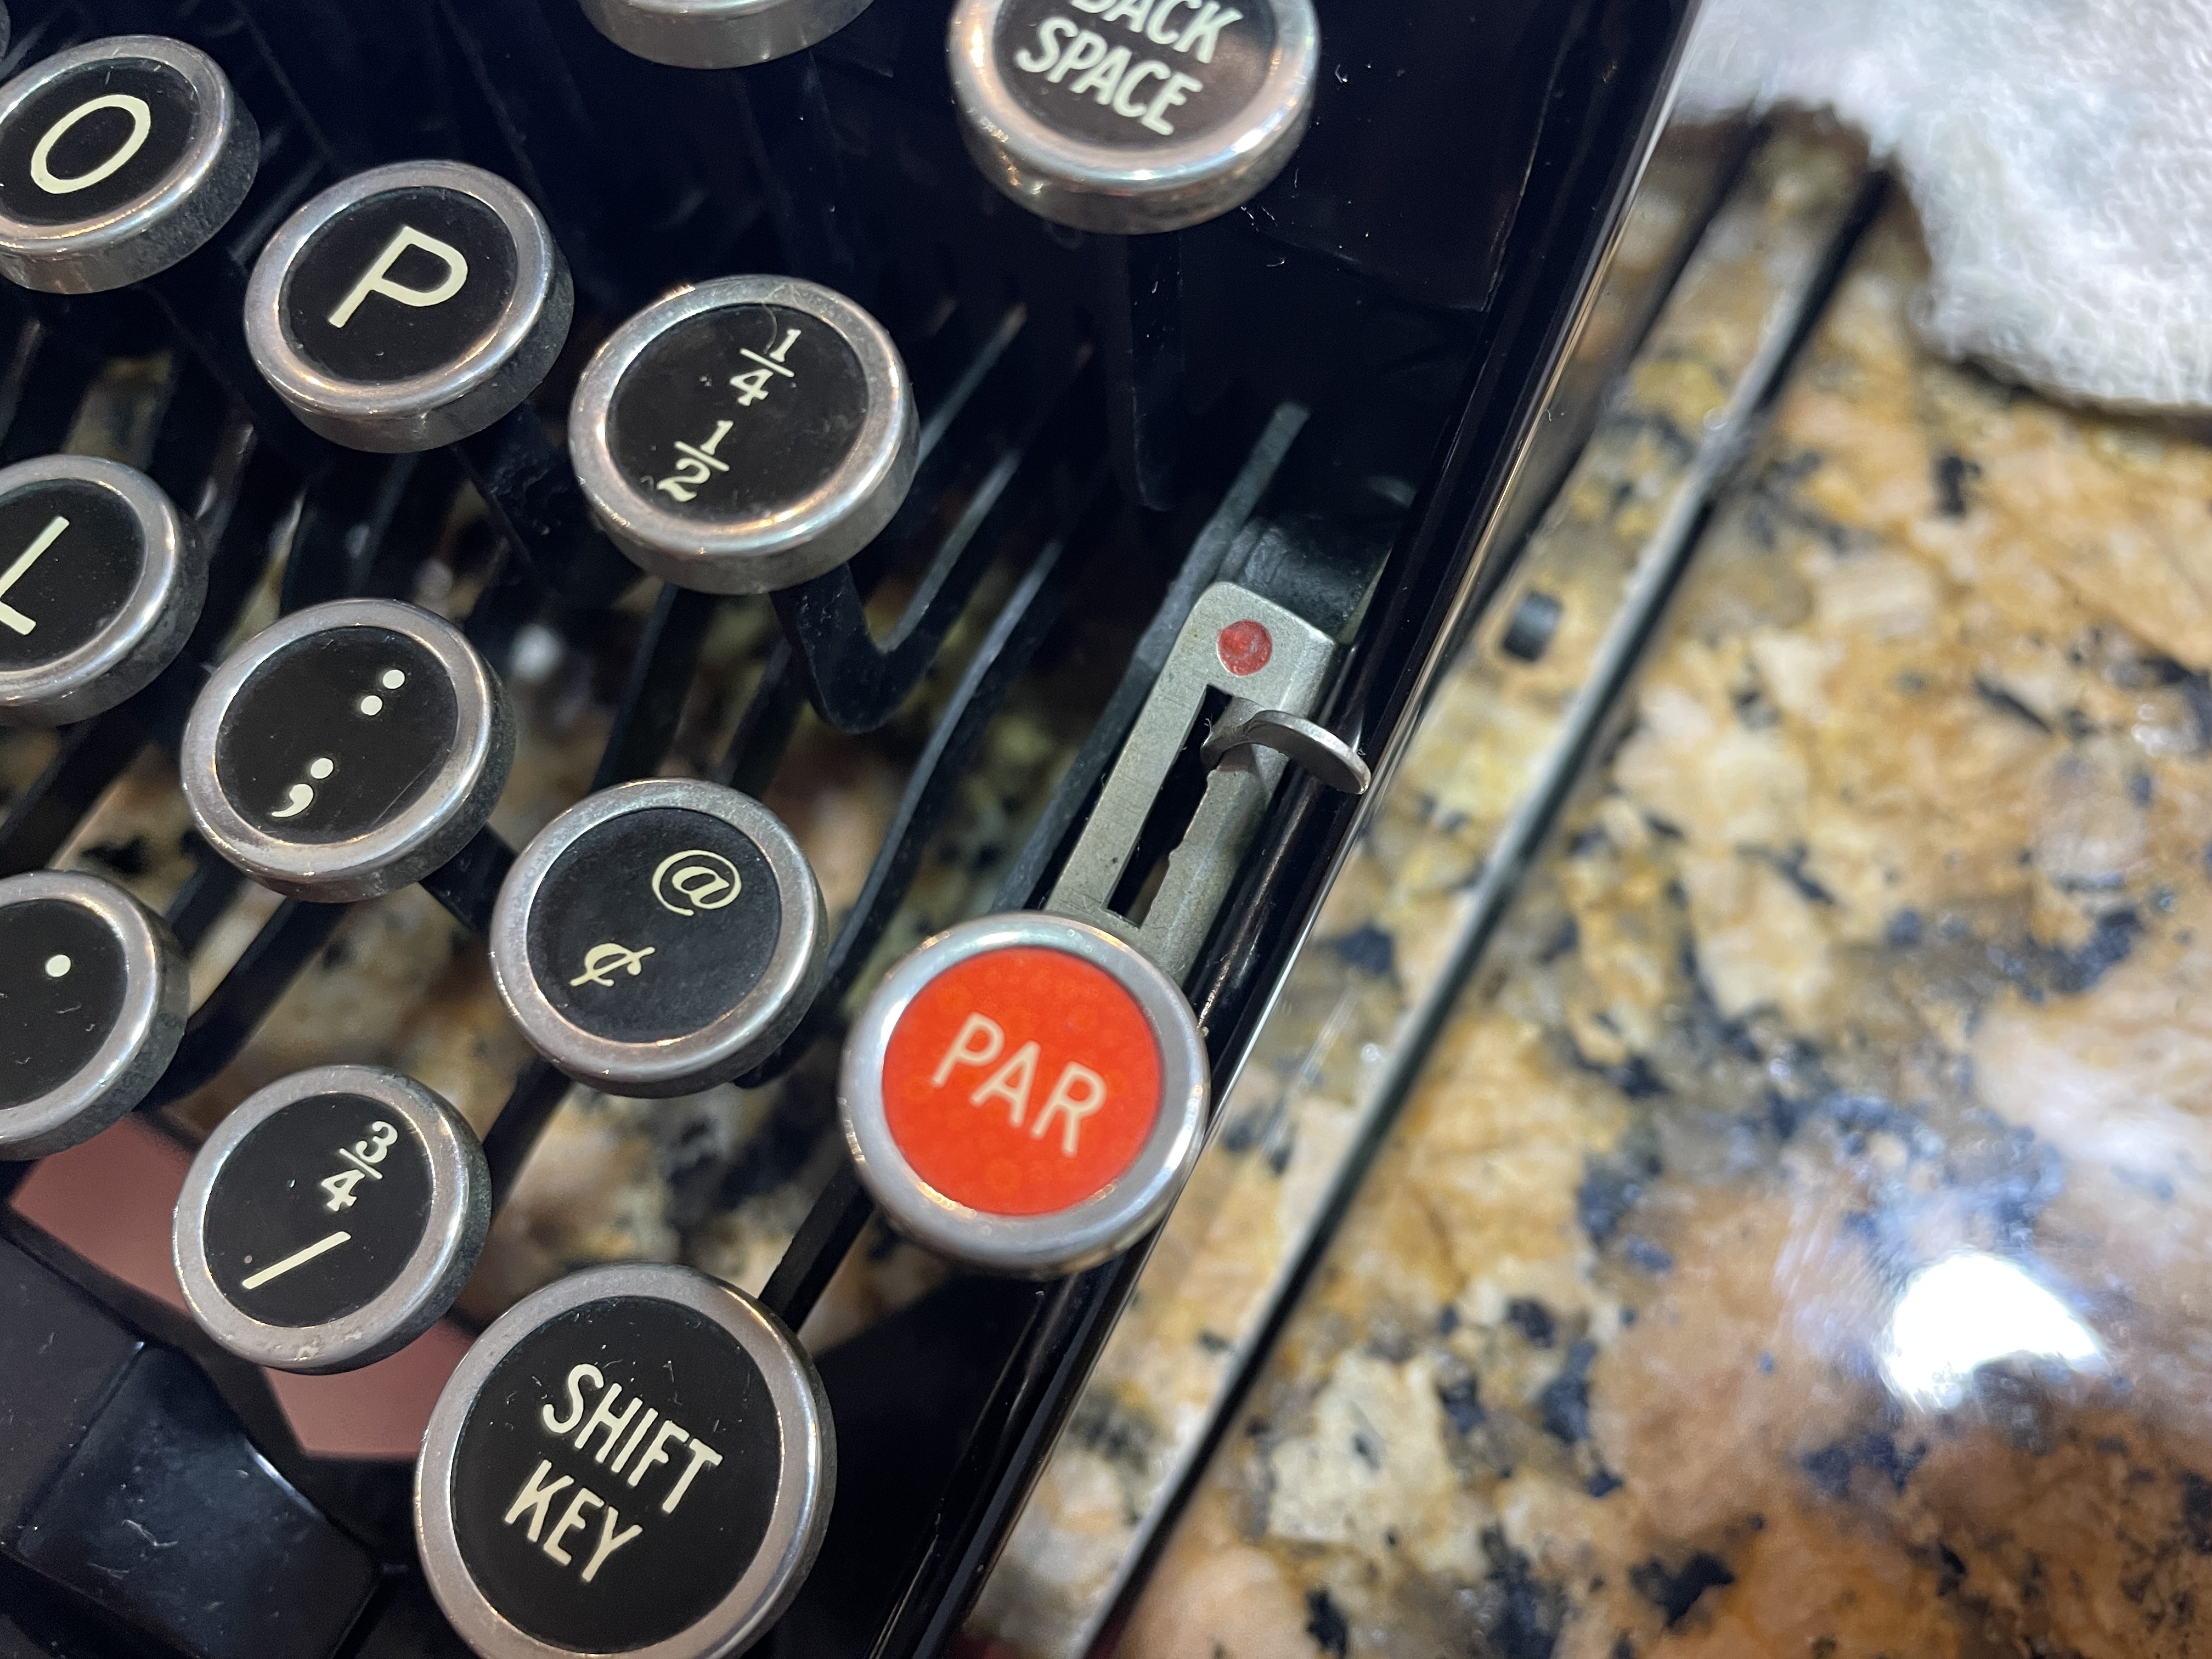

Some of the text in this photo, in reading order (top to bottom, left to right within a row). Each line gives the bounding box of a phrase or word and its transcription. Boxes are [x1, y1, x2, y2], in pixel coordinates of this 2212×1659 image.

[1015, 16, 1204, 136] SPACE
[1070, 0, 1244, 64] ACK
[31, 94, 151, 194] O
[329, 226, 467, 328] P
[652, 850, 741, 916] @
[571, 944, 655, 986] ¢
[933, 1013, 1107, 1156] PAR
[543, 1364, 723, 1514] SHIFT
[504, 1460, 642, 1582] KEY
